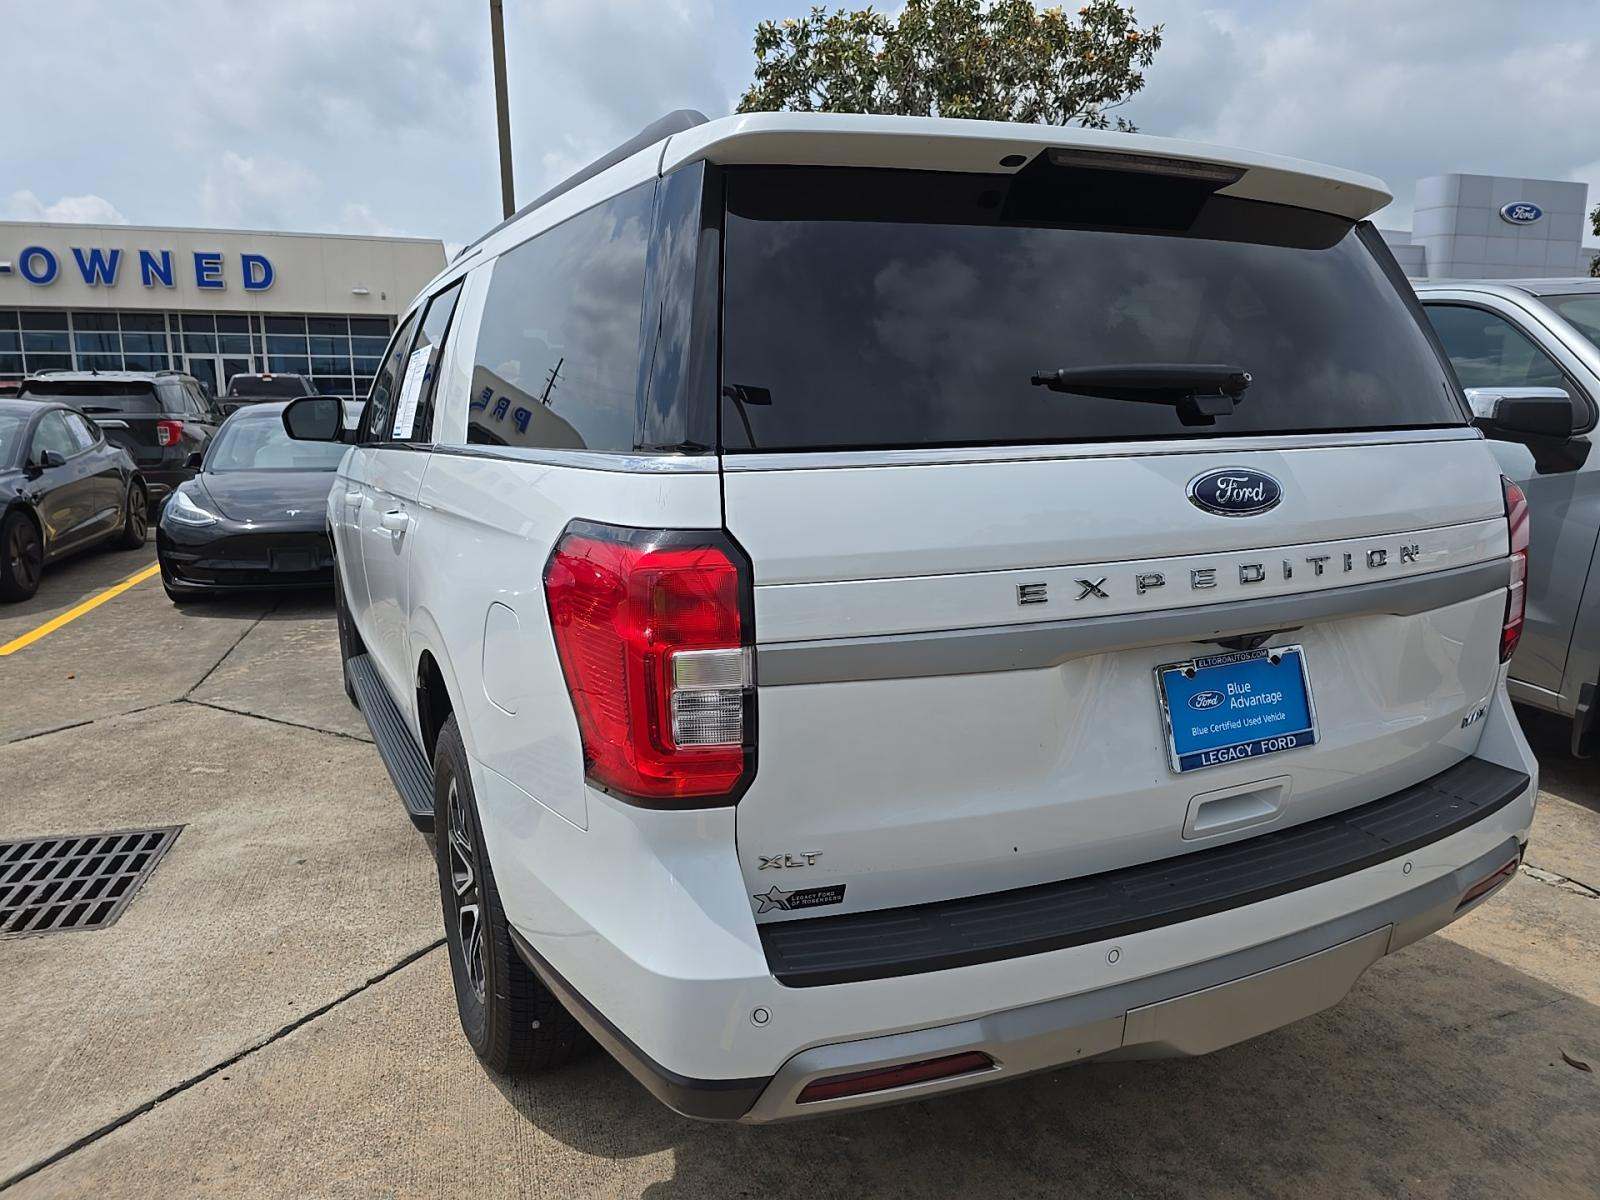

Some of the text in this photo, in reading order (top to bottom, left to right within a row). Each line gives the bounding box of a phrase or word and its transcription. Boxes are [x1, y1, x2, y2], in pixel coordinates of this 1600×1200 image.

[1215, 476, 1267, 504] Ford
[1015, 543, 1420, 606] EXPEDITION
[1198, 649, 1268, 668] ELTOROAUTOS.COM
[1194, 682, 1252, 708] Ford Blue
[1230, 690, 1283, 710] Advantage
[1191, 711, 1286, 737] Blue Certified Used Vehicle
[1201, 735, 1297, 766] LEGACY FORD
[758, 850, 824, 870] XLT
